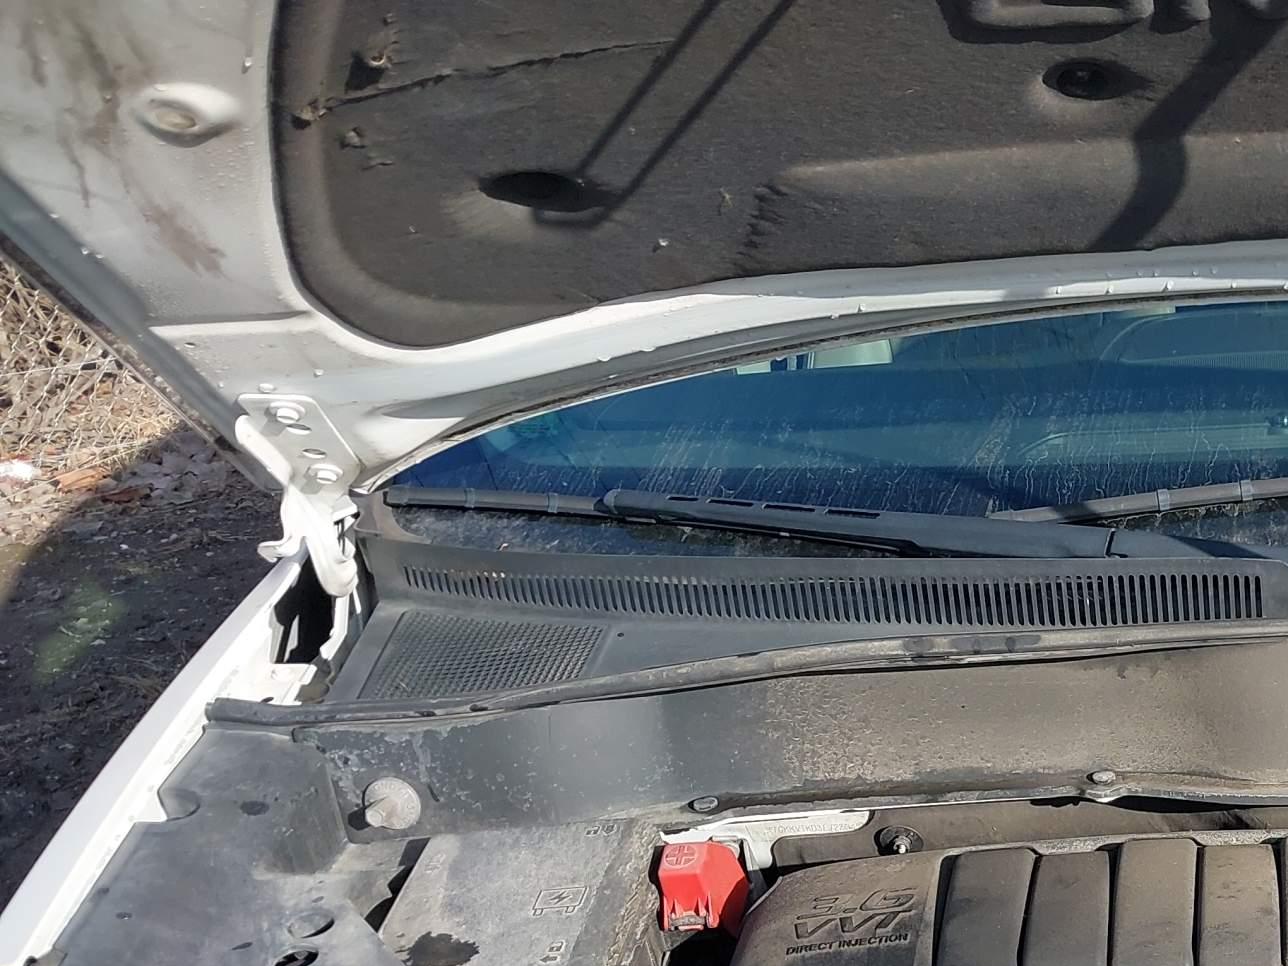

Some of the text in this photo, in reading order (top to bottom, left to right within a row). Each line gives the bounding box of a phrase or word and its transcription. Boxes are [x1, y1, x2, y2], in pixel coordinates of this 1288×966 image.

[796, 886, 917, 921] 3.6
[794, 909, 913, 940] VVT
[785, 932, 909, 956] DIRECT INJECTION
